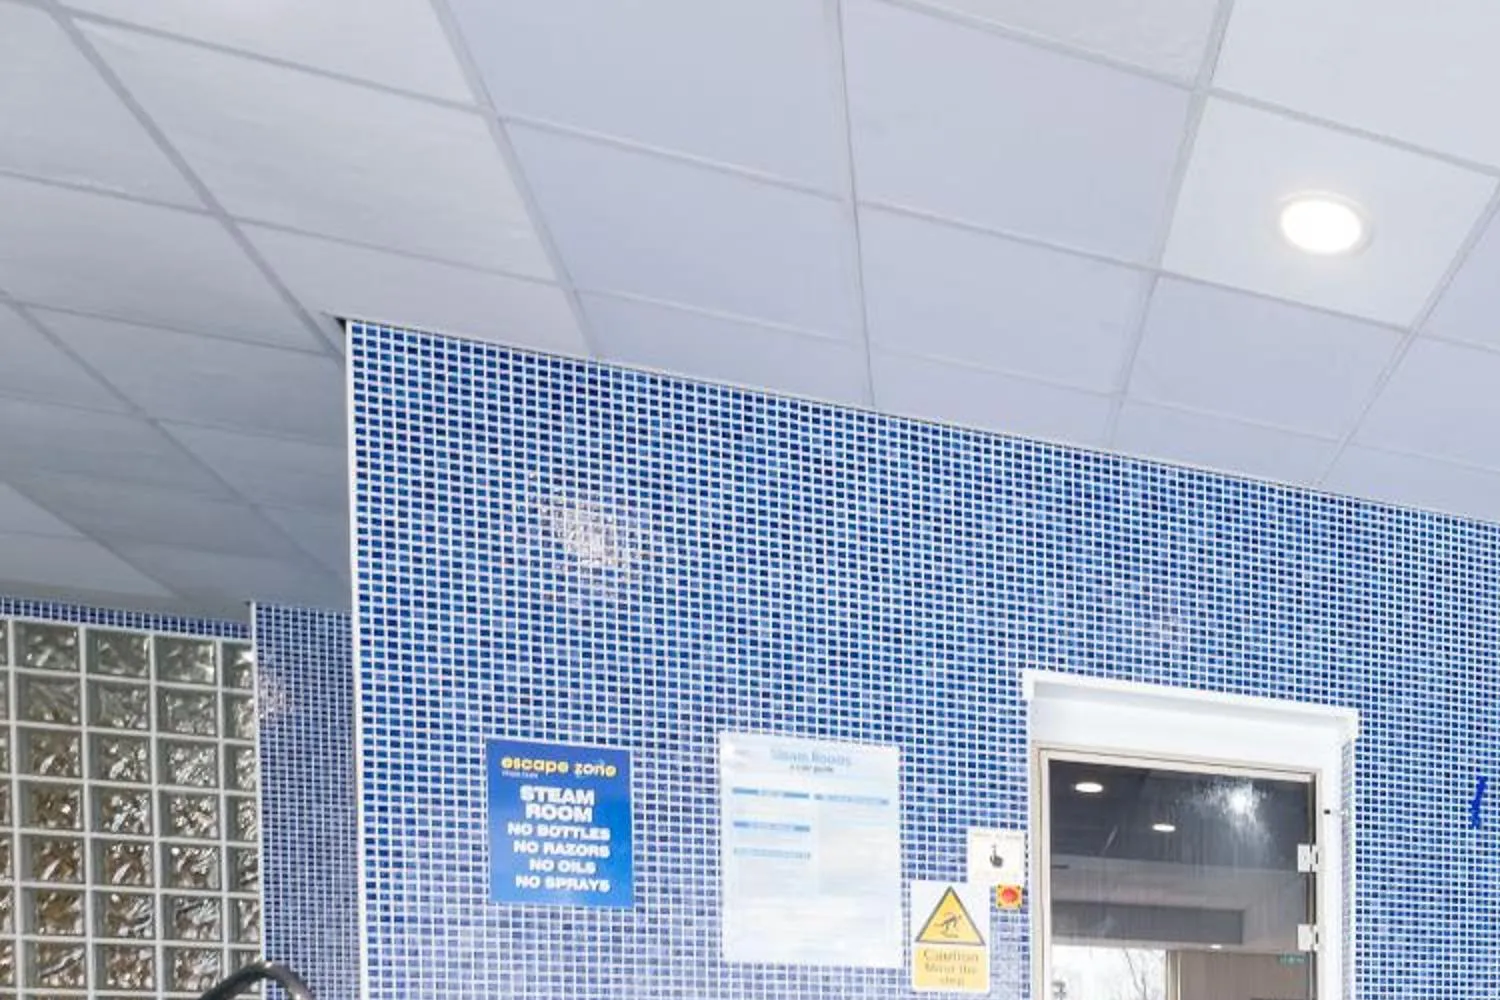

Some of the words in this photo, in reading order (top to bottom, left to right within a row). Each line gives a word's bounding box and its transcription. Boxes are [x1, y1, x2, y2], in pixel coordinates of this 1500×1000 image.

[501, 757, 569, 775] escape
[574, 762, 618, 777] zone
[520, 785, 595, 807] STEAM
[525, 803, 593, 823] ROOM
[507, 821, 533, 836] NO
[537, 824, 611, 841] BOTTLES
[513, 839, 539, 854] NO
[544, 842, 611, 858] RAZORS
[529, 858, 554, 873] NO
[557, 859, 597, 874] OILS
[515, 875, 541, 889] NO
[545, 877, 611, 893] SPRAYS
